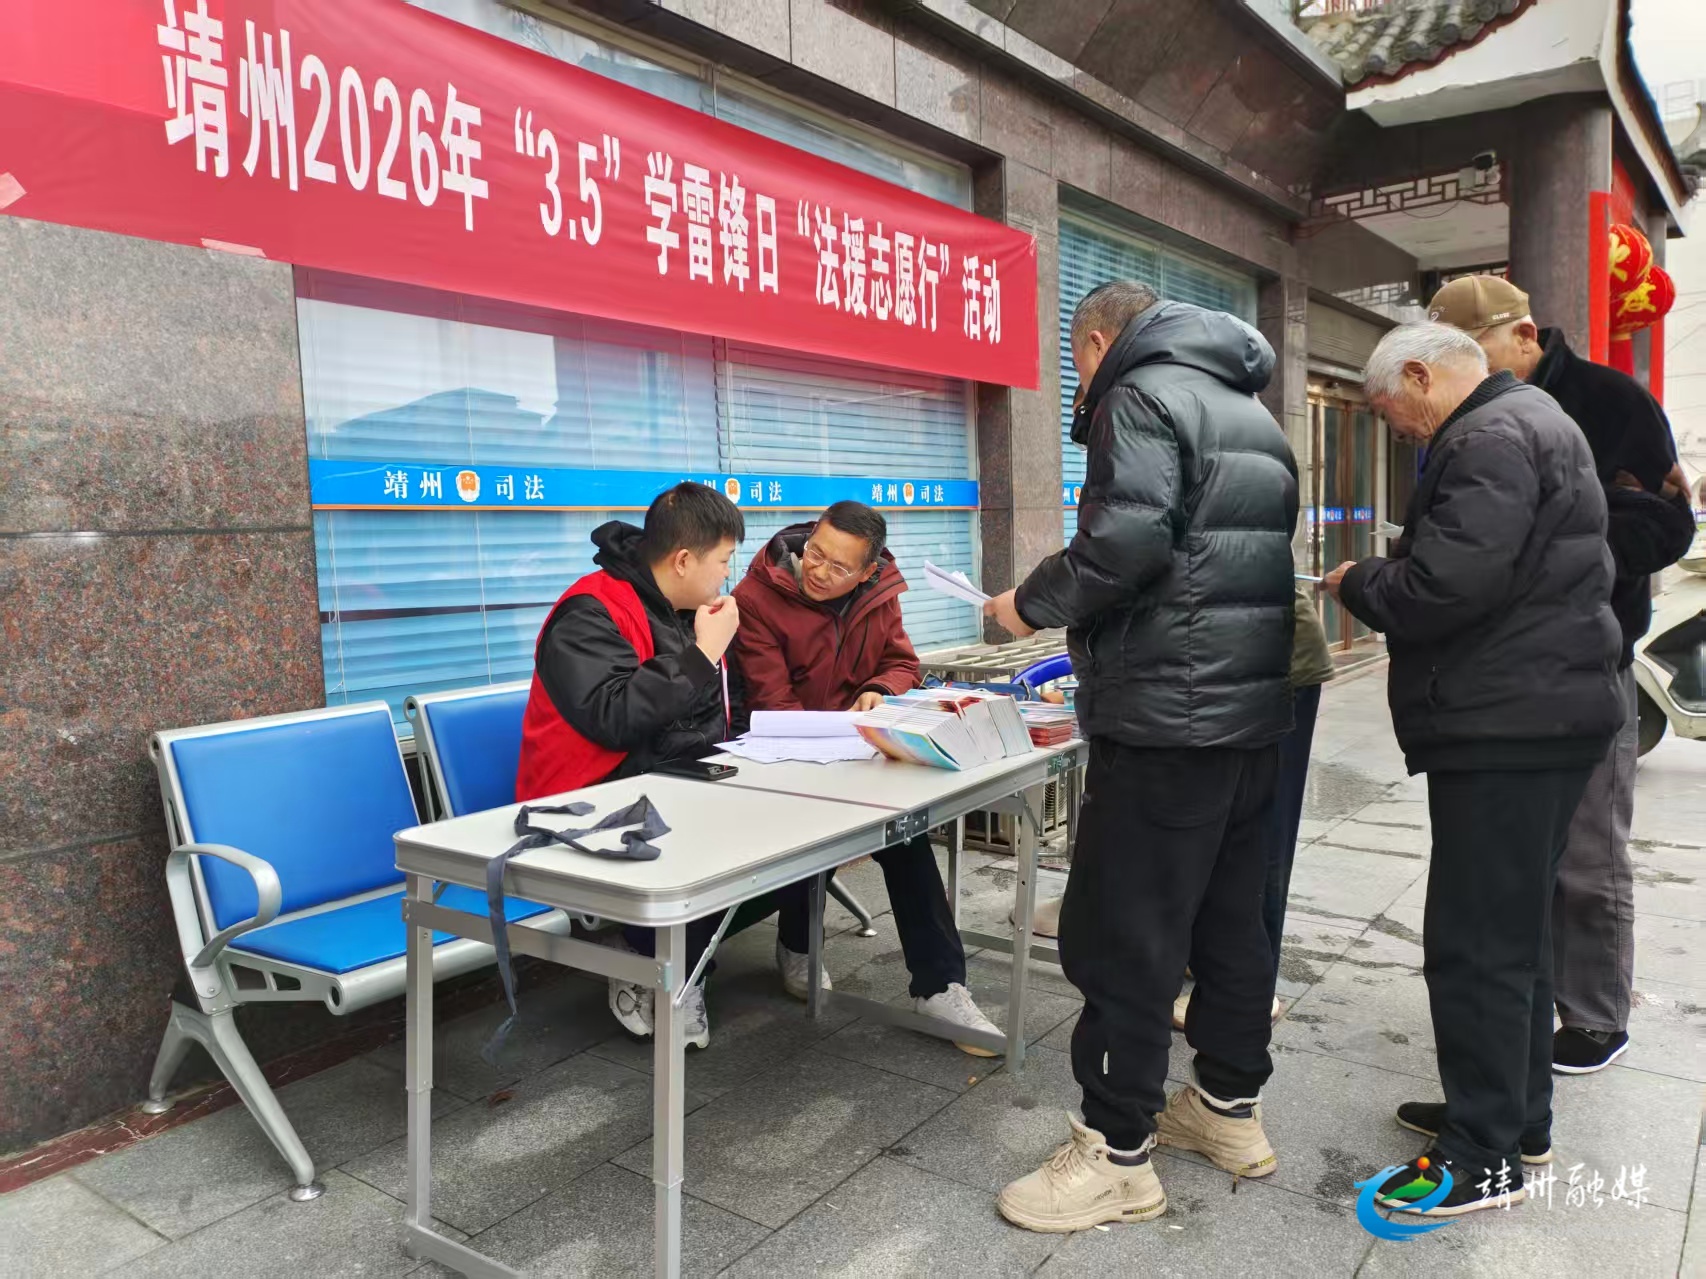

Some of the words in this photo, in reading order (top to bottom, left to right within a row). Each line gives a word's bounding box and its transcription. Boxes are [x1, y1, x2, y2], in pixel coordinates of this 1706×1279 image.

[384, 470, 443, 499] 靖州
[494, 474, 545, 501] 司法
[748, 480, 782, 502] 司法
[872, 483, 898, 503] 靖州
[920, 484, 944, 503] 司法
